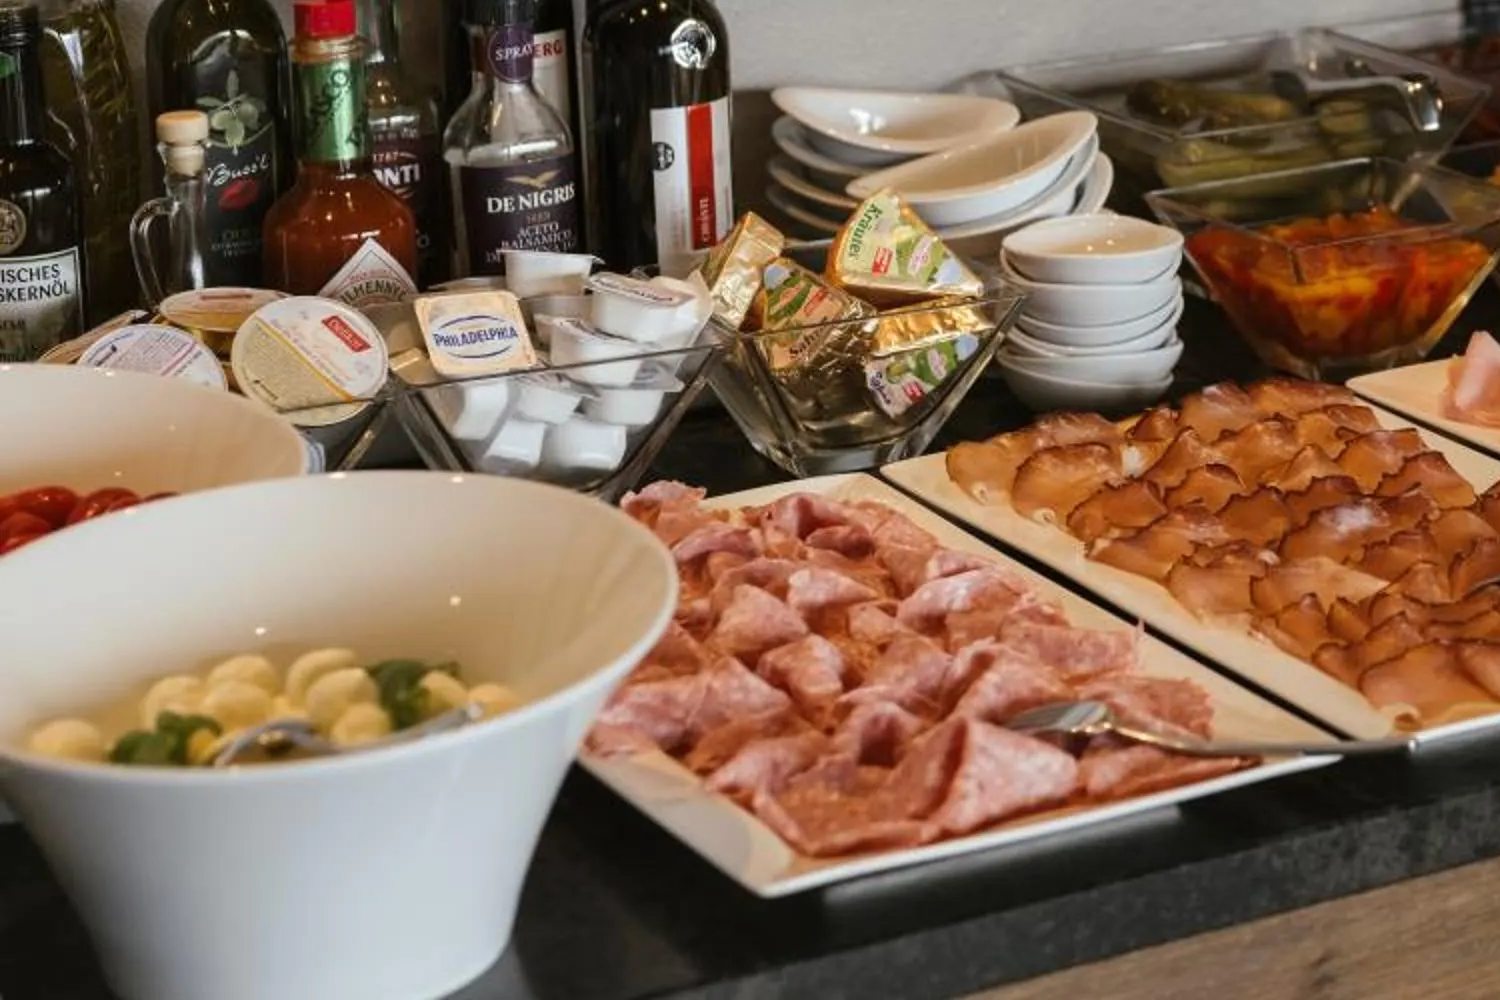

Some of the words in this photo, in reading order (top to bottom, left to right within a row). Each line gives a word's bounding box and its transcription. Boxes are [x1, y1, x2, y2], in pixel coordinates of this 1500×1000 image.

[486, 196, 516, 214] DE
[518, 182, 575, 211] NIGRIS
[432, 326, 518, 348] PHILADELPHIA
